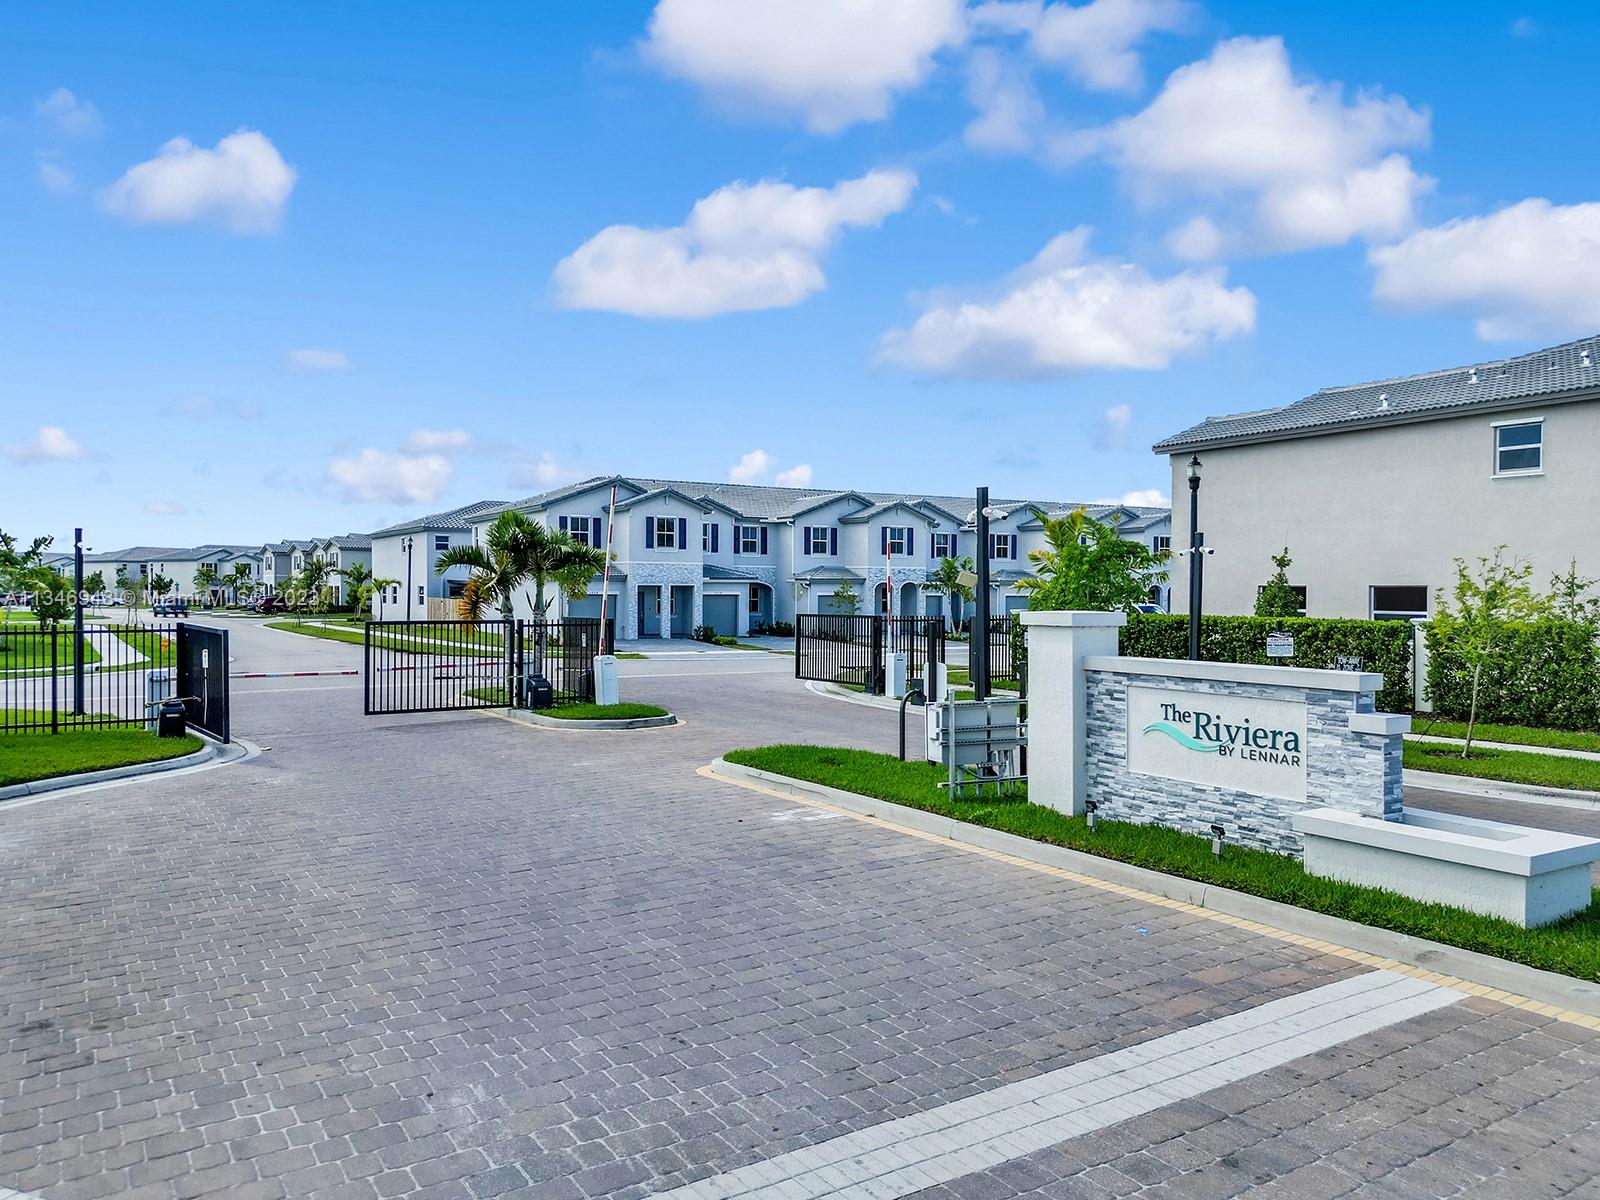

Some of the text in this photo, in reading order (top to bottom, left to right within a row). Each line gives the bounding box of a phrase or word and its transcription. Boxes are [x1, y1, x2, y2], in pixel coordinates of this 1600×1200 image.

[1160, 703, 1301, 753] The Riviera
[1219, 745, 1301, 767] BY LENNAR
